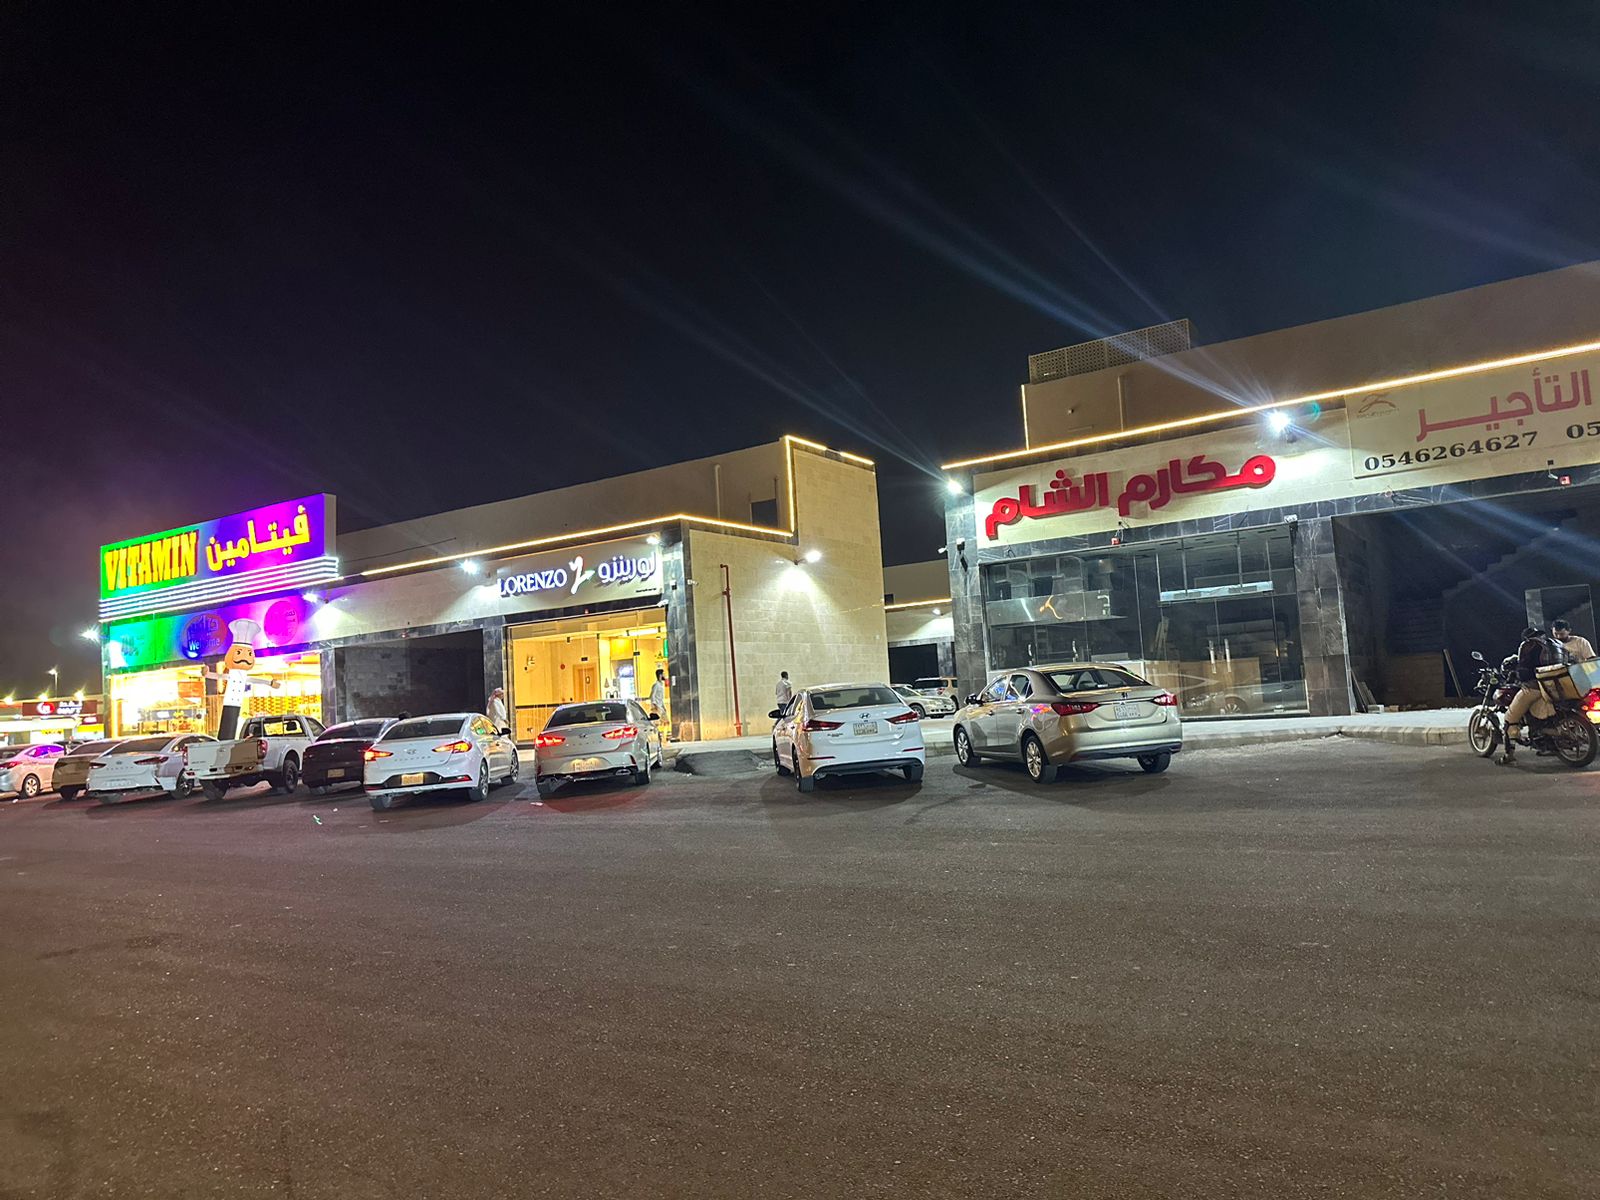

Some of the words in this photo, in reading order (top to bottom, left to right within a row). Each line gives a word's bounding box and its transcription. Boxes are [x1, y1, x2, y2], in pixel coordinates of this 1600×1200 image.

[1364, 431, 1538, 471] 0546264627
[985, 469, 1108, 540] الشام
[1118, 454, 1276, 517] مكارم
[104, 532, 199, 590] VITAMIN
[206, 505, 311, 571] فيتامين
[498, 568, 568, 596] LORENZO
[598, 552, 657, 584] لورينزو
